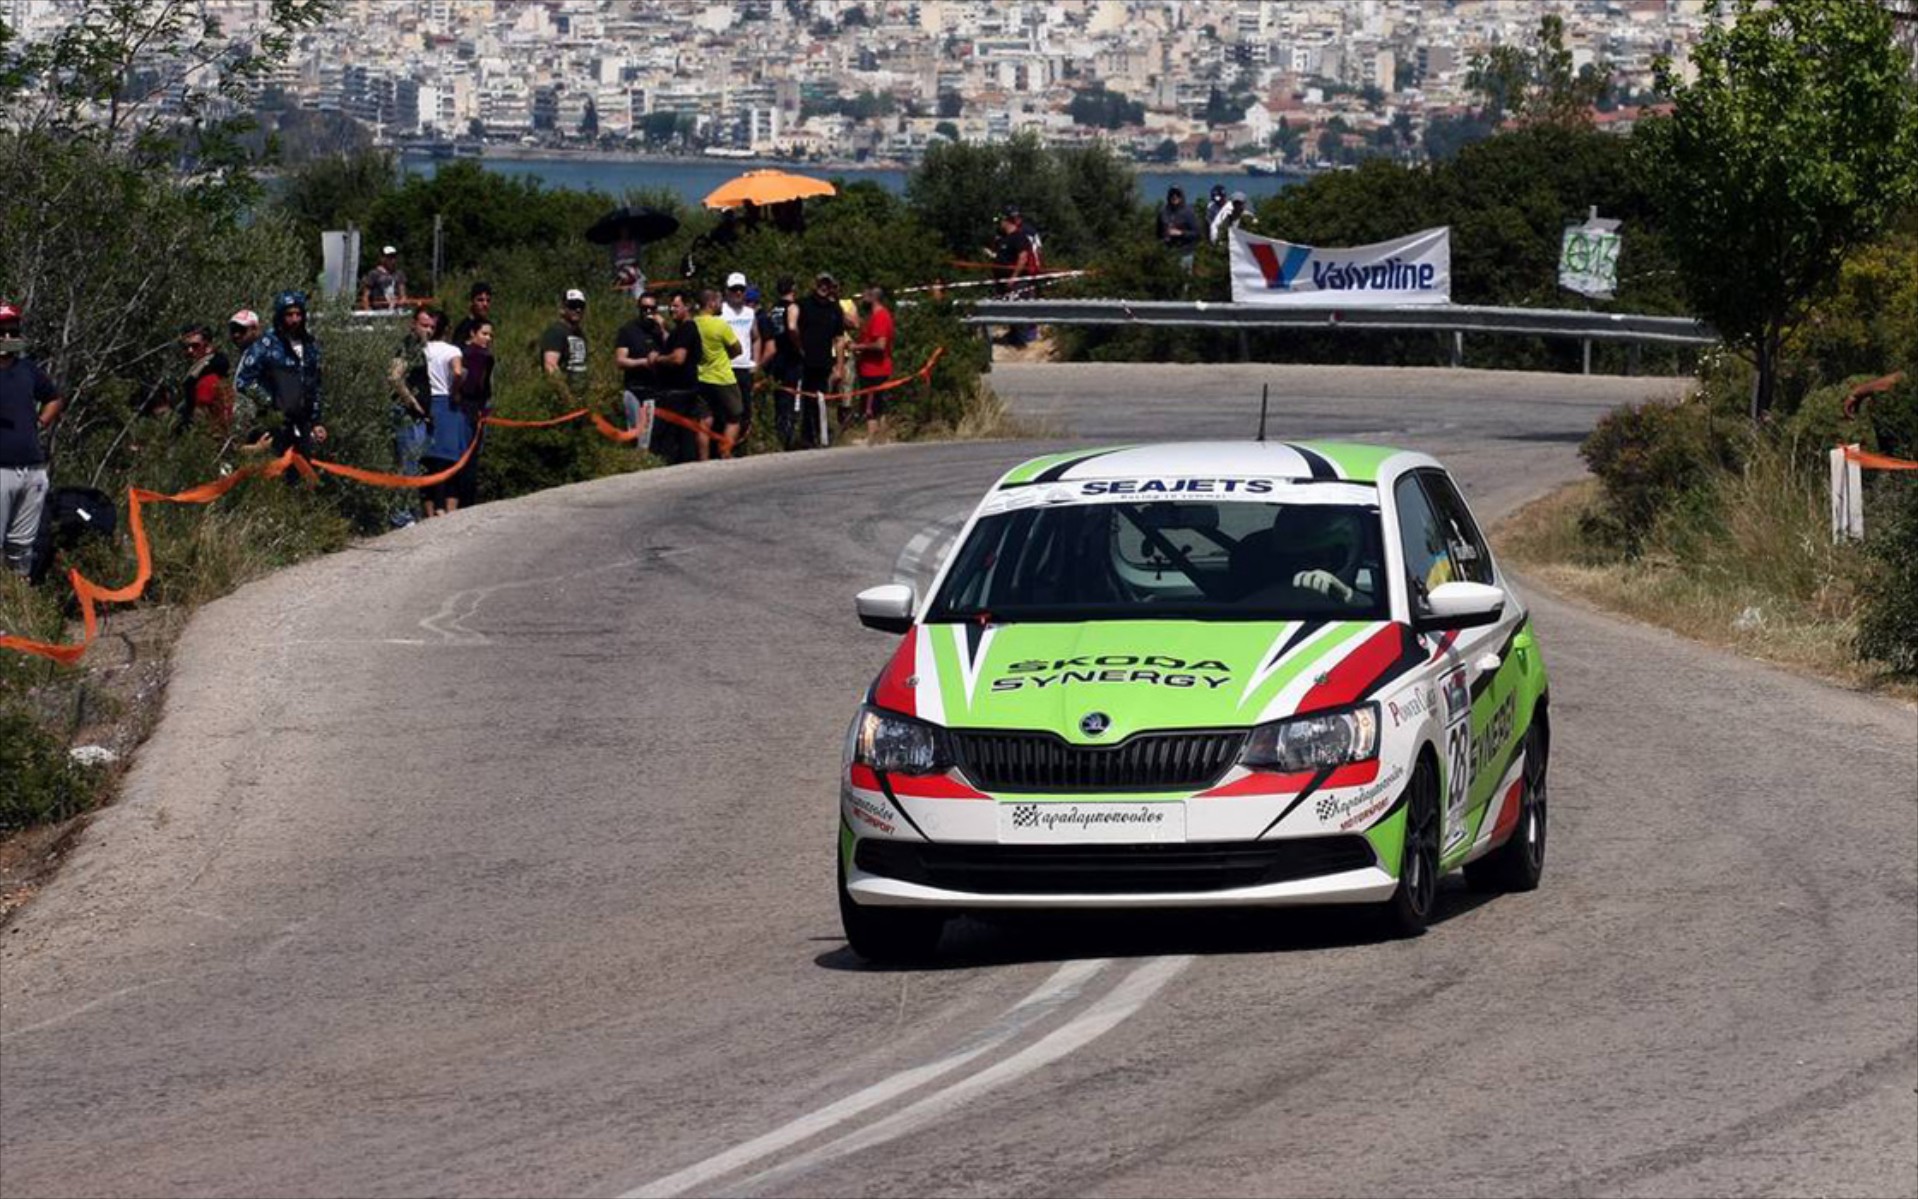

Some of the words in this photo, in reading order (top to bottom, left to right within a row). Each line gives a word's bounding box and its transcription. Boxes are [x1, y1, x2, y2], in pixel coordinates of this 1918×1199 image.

[1313, 259, 1434, 290] Valvoline
[1081, 479, 1274, 495] SEAJETS
[991, 670, 1231, 692] SYNERGY
[1448, 722, 1468, 813] 28
